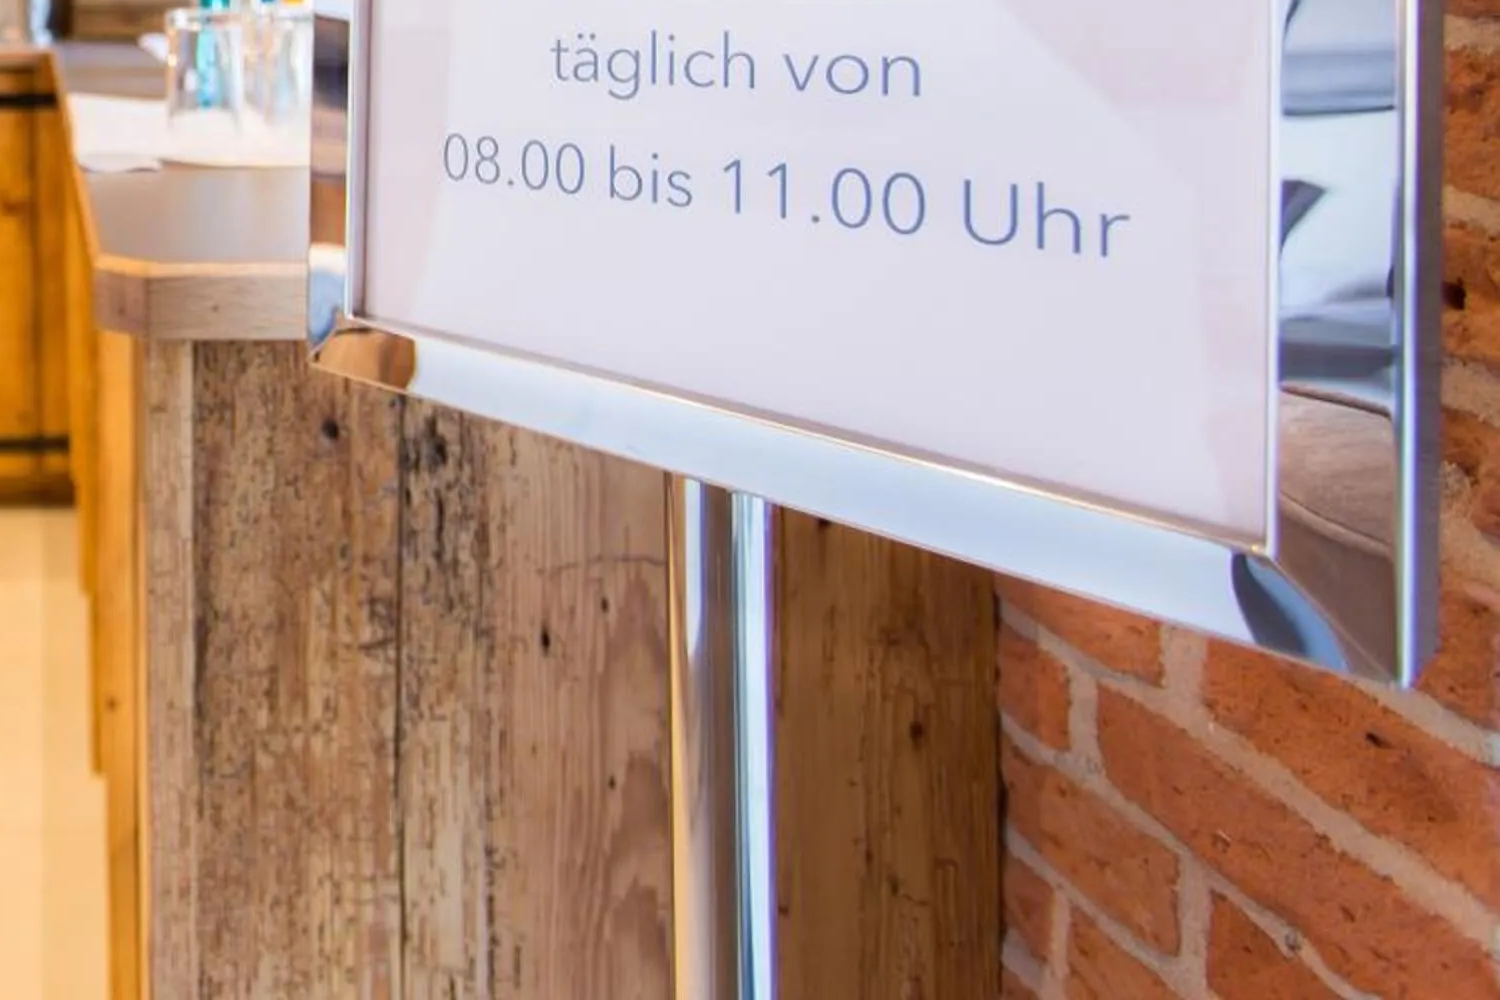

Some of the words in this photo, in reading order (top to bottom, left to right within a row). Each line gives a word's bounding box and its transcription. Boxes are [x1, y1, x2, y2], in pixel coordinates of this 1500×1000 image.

[549, 29, 757, 101] täglich
[781, 52, 922, 98] von
[442, 131, 587, 195] 08.00
[608, 143, 695, 208] bis
[721, 157, 928, 236] 11.00
[962, 177, 1132, 259] Uhr
